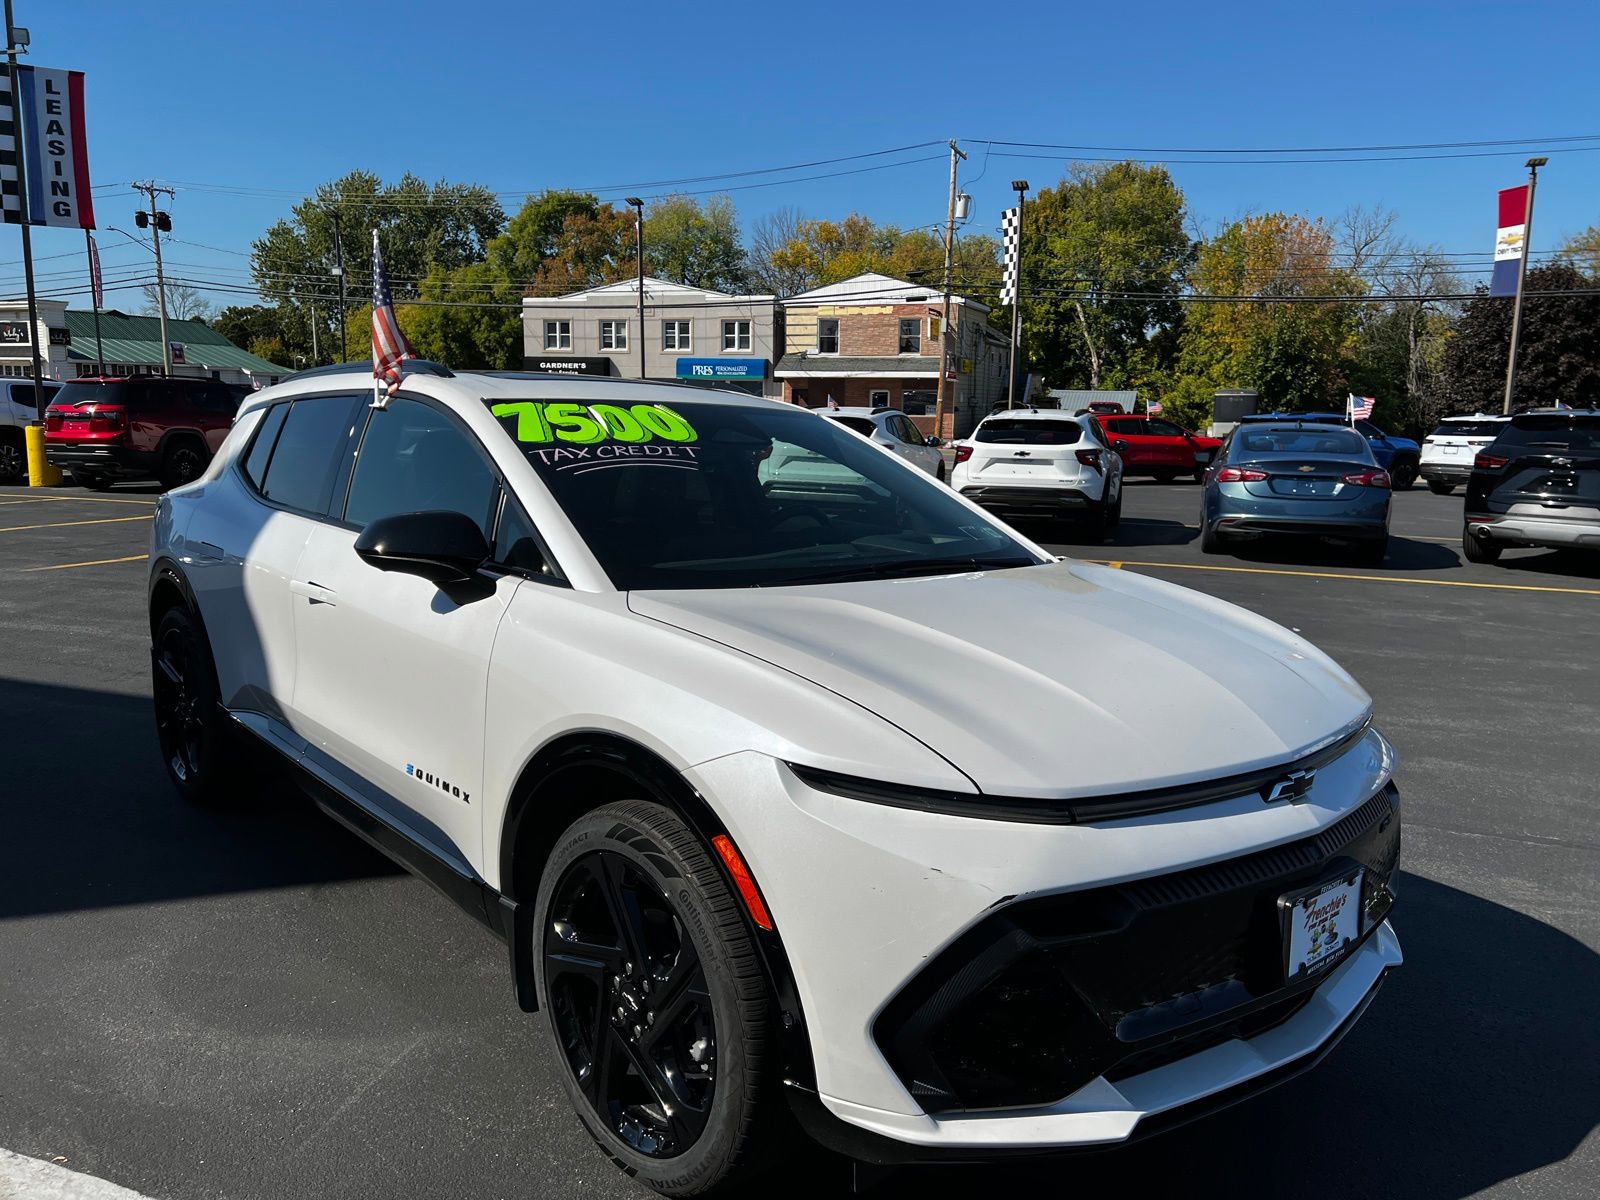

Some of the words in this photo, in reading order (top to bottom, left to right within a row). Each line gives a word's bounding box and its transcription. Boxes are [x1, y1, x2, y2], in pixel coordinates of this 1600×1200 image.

[44, 79, 72, 217] LEASING
[692, 365, 713, 376] PRES
[491, 402, 699, 444] 7500
[529, 447, 591, 465] TAX
[597, 445, 701, 459] CREDIT
[405, 762, 471, 804] EQUINOX
[1303, 893, 1347, 929] Frenchie's
